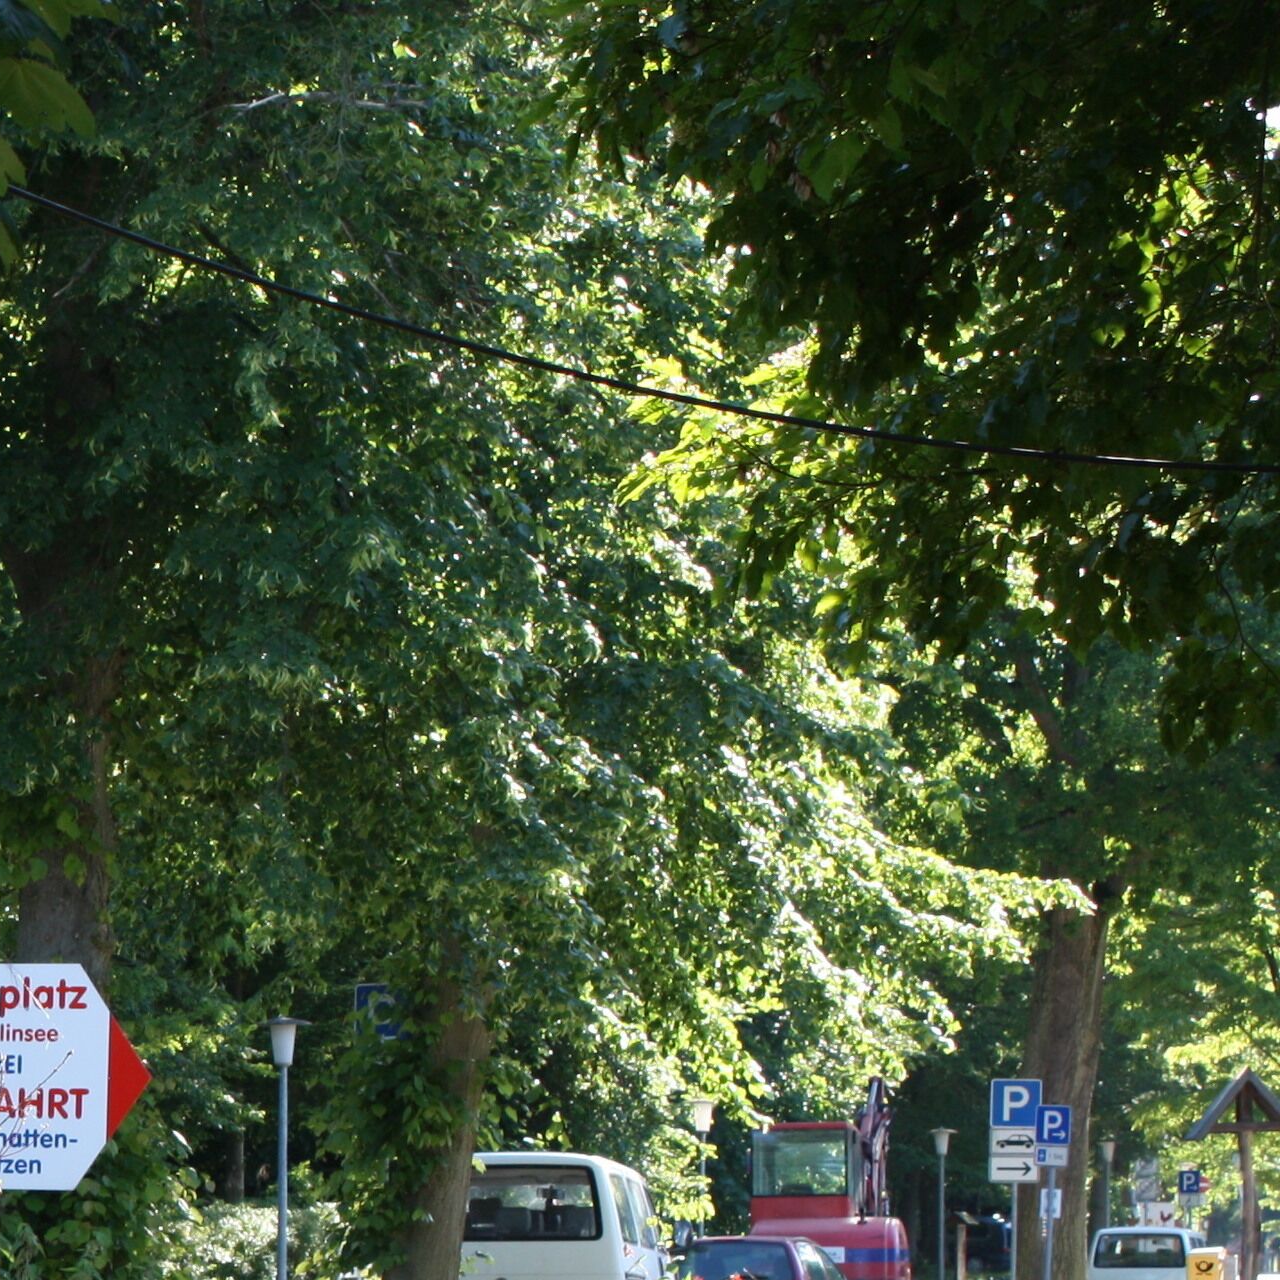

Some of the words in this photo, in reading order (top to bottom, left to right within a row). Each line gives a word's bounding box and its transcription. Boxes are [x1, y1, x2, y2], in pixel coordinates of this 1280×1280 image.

[1002, 1084, 1031, 1123] P
[1042, 1109, 1063, 1141] P
[1182, 1173, 1197, 1192] P
